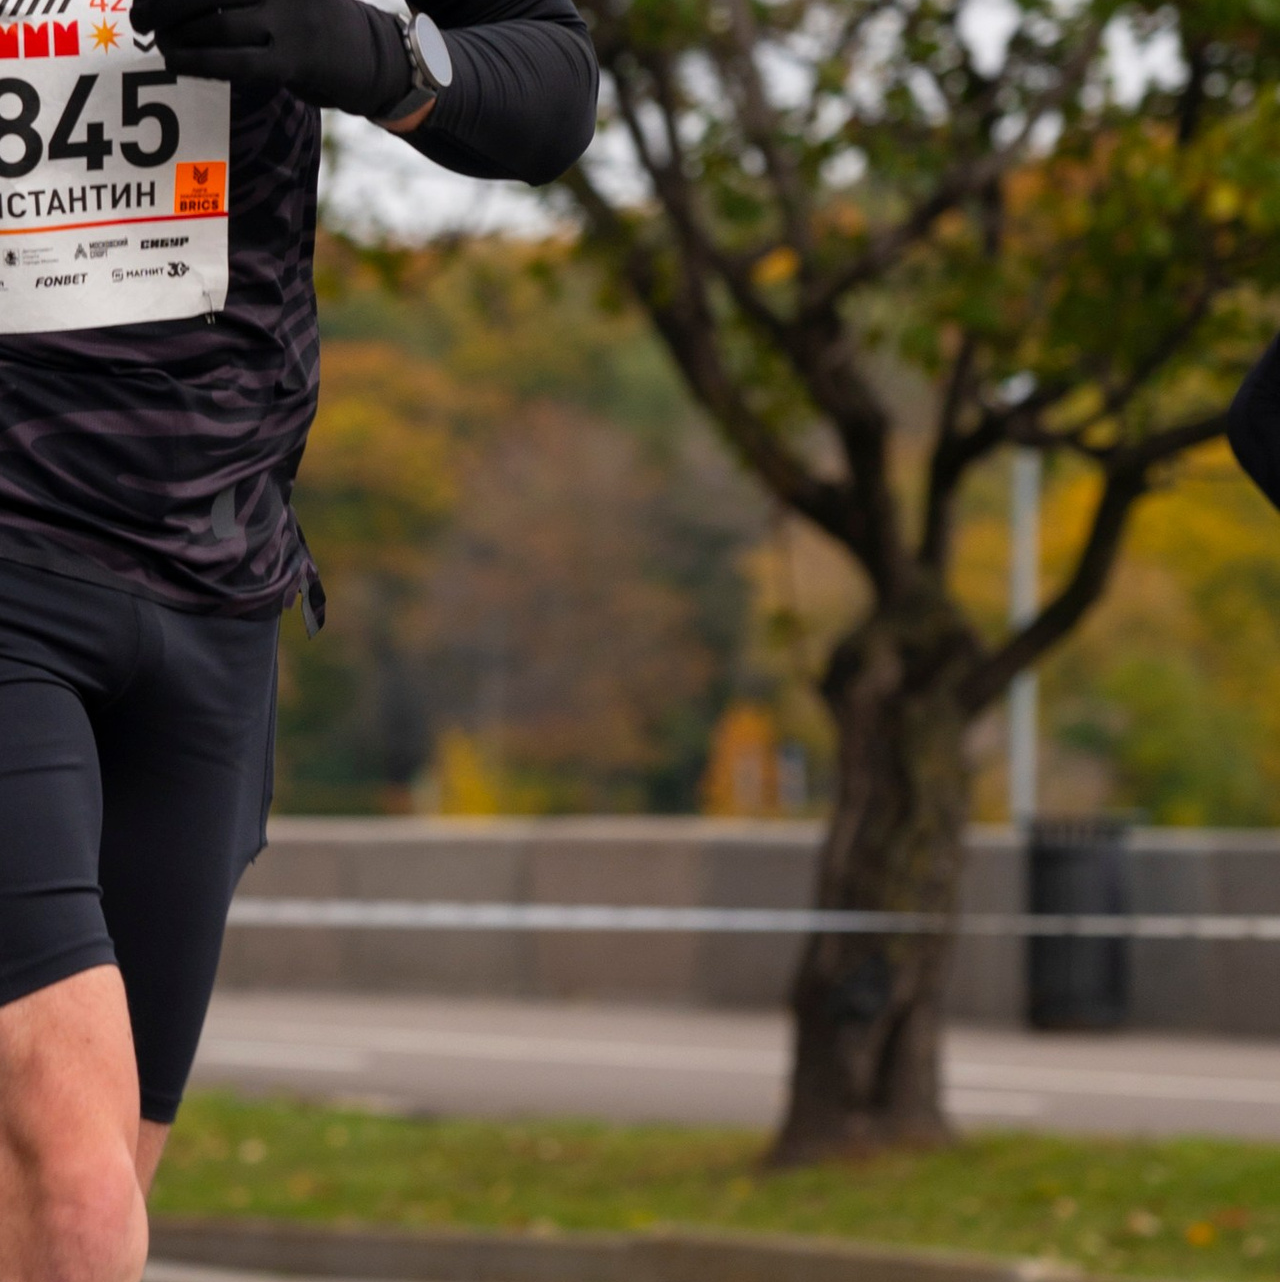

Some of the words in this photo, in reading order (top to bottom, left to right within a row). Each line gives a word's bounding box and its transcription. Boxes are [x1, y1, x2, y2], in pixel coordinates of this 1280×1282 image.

[179, 199, 220, 213] BRICS
[140, 236, 190, 250] СИБУР
[126, 267, 165, 279] МАГНИТ
[34, 272, 89, 289] FONBET
